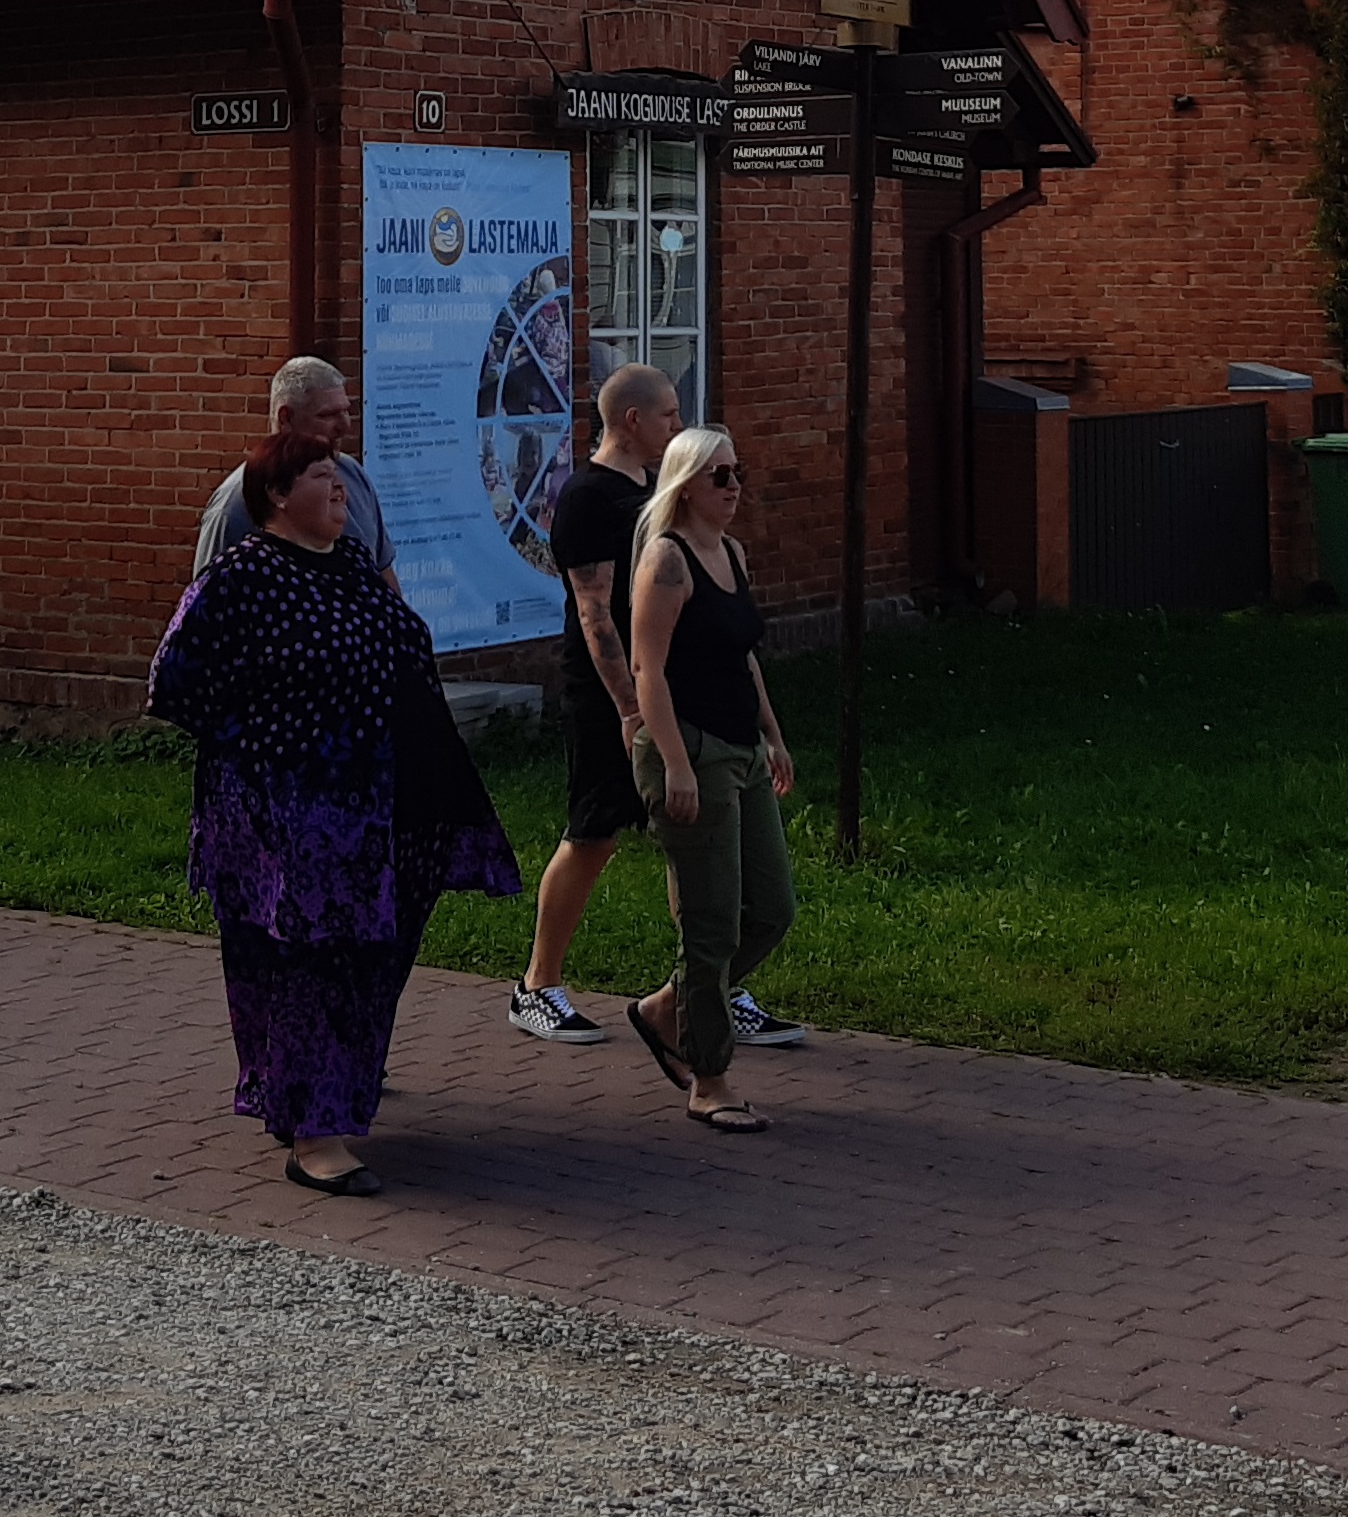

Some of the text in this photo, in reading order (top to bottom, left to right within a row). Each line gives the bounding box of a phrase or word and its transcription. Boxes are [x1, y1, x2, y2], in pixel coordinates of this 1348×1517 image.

[754, 45, 822, 67] VILJANDI JÄRV
[941, 55, 1002, 70] VANALINN
[753, 61, 772, 73] LAKE
[954, 71, 1002, 83] OLD-TOWN
[734, 82, 782, 94] SUSPENSION
[202, 98, 279, 125] LOSSI 1
[421, 99, 440, 124] 10
[567, 88, 617, 120] JAANI
[620, 92, 691, 123] KOGUDUSE
[941, 97, 1001, 112] MUUSEUM
[733, 105, 803, 120] ORDULINNUS
[961, 114, 1001, 124] MUSEUM
[733, 120, 807, 132] THE ORDER CASTLE
[733, 145, 826, 159] PÄRIMUSMUUSIKA AIT
[892, 148, 965, 170] KONDASE KESKUS
[733, 159, 825, 170] TRADITIONAL MUSIC CENTER
[376, 217, 559, 255] JAANI LASTEMAJA
[376, 275, 392, 294] Too
[415, 275, 434, 295] laps
[437, 274, 461, 293] meile
